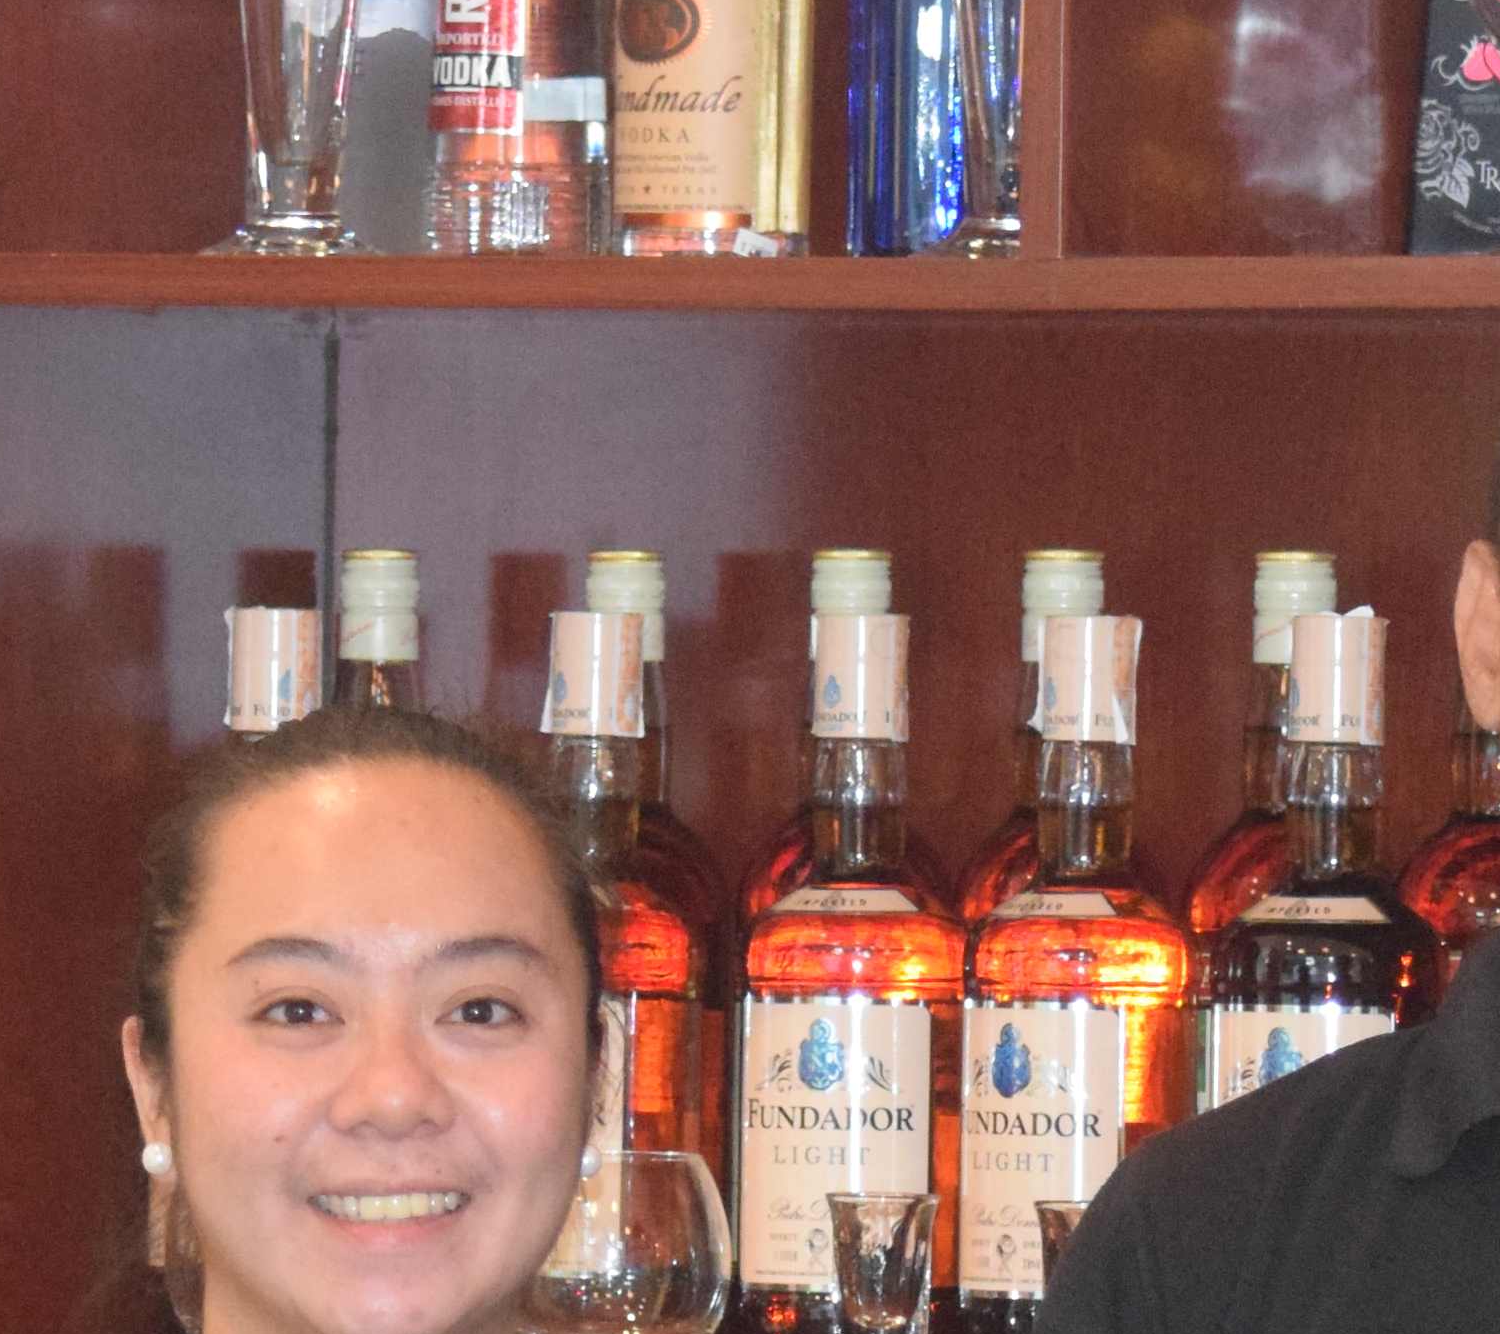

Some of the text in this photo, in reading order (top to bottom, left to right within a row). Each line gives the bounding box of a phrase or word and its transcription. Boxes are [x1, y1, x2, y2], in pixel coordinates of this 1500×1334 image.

[433, 54, 513, 88] VODKA
[748, 1098, 915, 1132] FUNDADOR
[773, 1145, 871, 1165] LIGHT
[972, 1151, 1054, 1172] LIGHT
